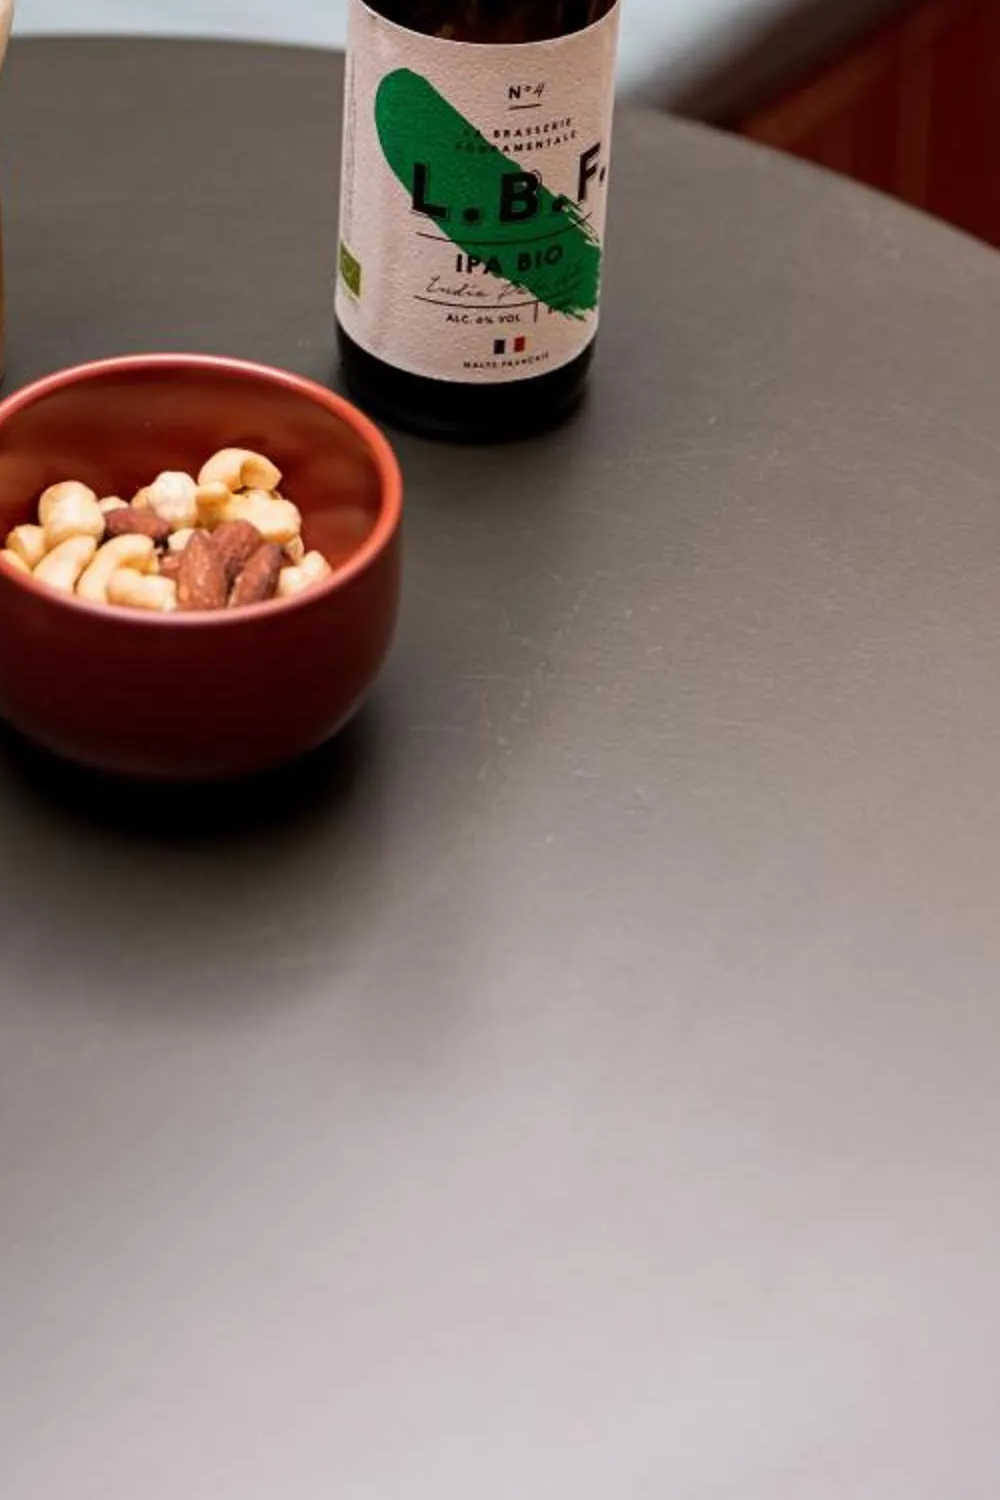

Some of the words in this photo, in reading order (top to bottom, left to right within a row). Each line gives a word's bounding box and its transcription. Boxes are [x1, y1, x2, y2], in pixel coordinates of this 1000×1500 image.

[493, 117, 573, 139] BRASSERIE
[456, 254, 502, 275] IPA
[517, 245, 564, 272] BIO
